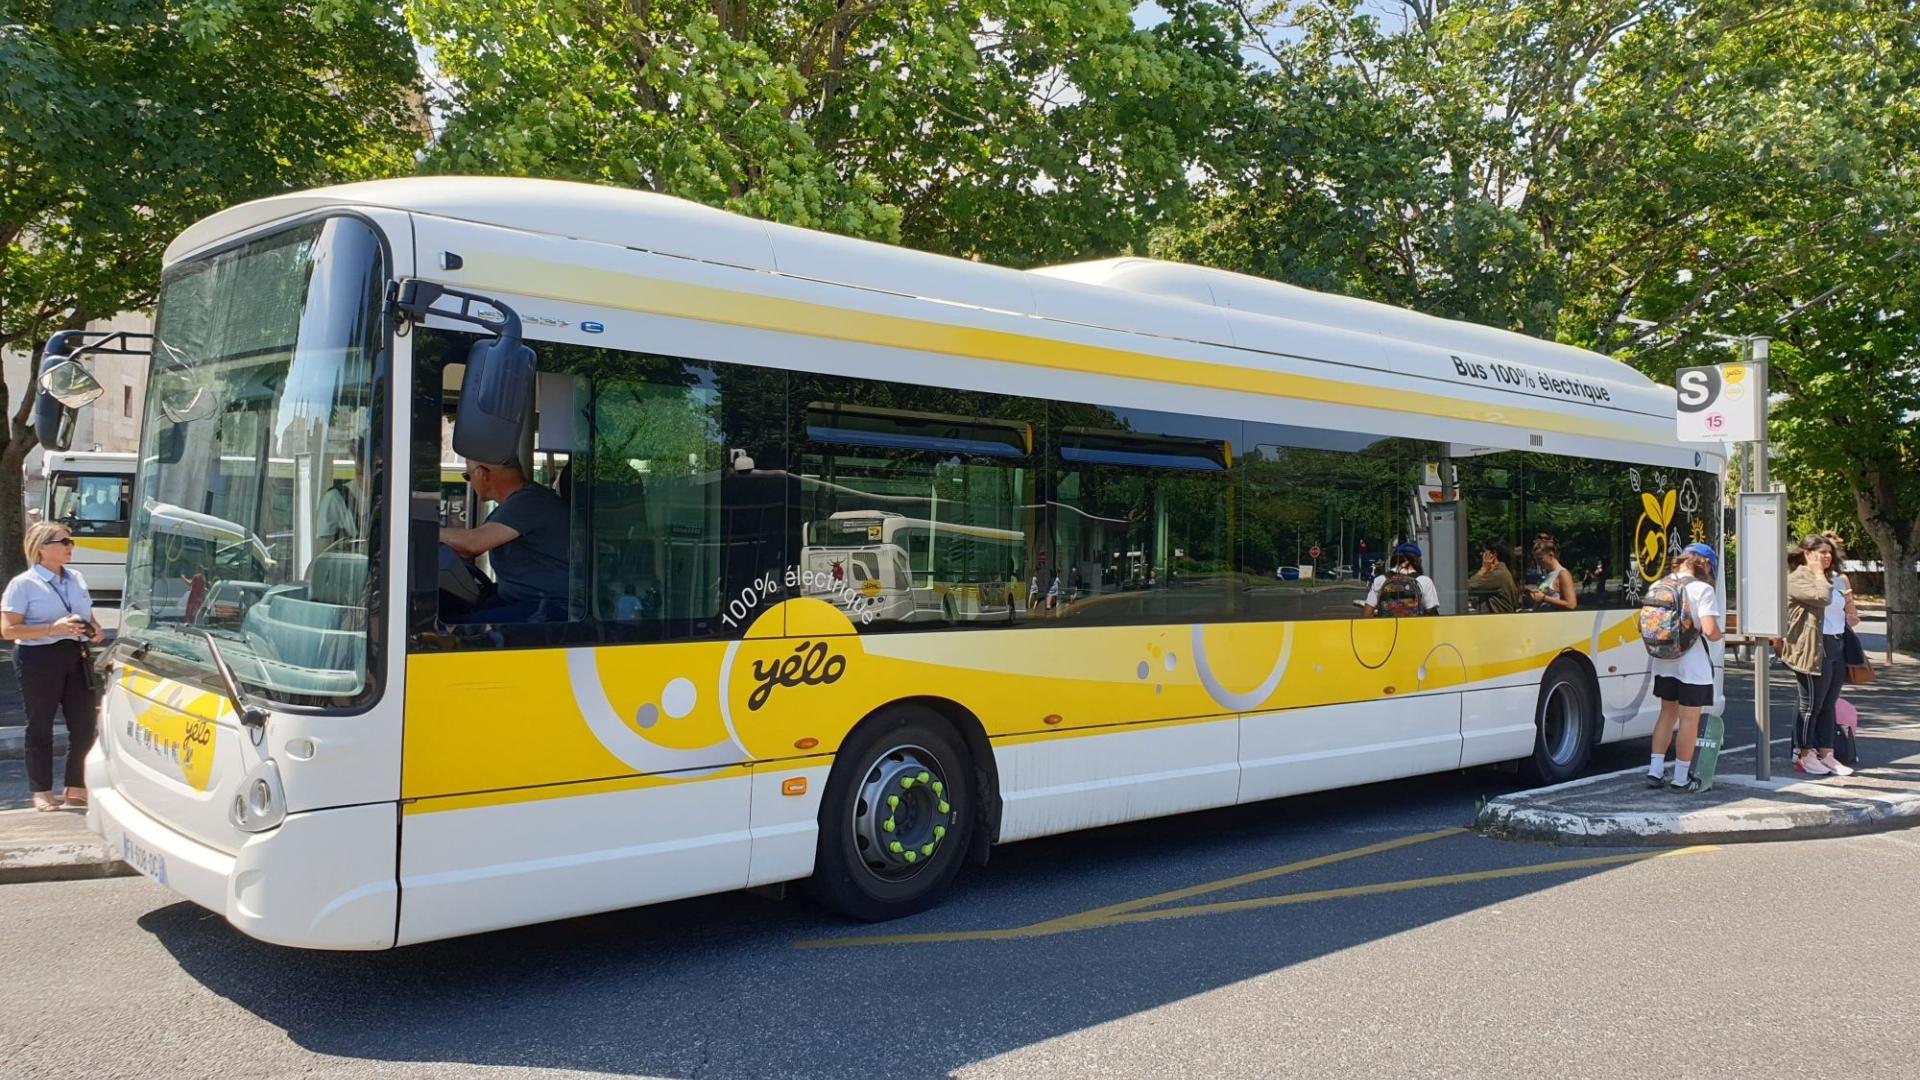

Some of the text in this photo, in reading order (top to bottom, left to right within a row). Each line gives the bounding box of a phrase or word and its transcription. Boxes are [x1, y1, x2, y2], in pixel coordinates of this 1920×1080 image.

[1450, 355, 1611, 403] Bus 100% électrique
[1679, 370, 1710, 406] S
[1706, 415, 1723, 428] 15
[721, 564, 874, 629] 100% électrique
[748, 640, 847, 712] yélo
